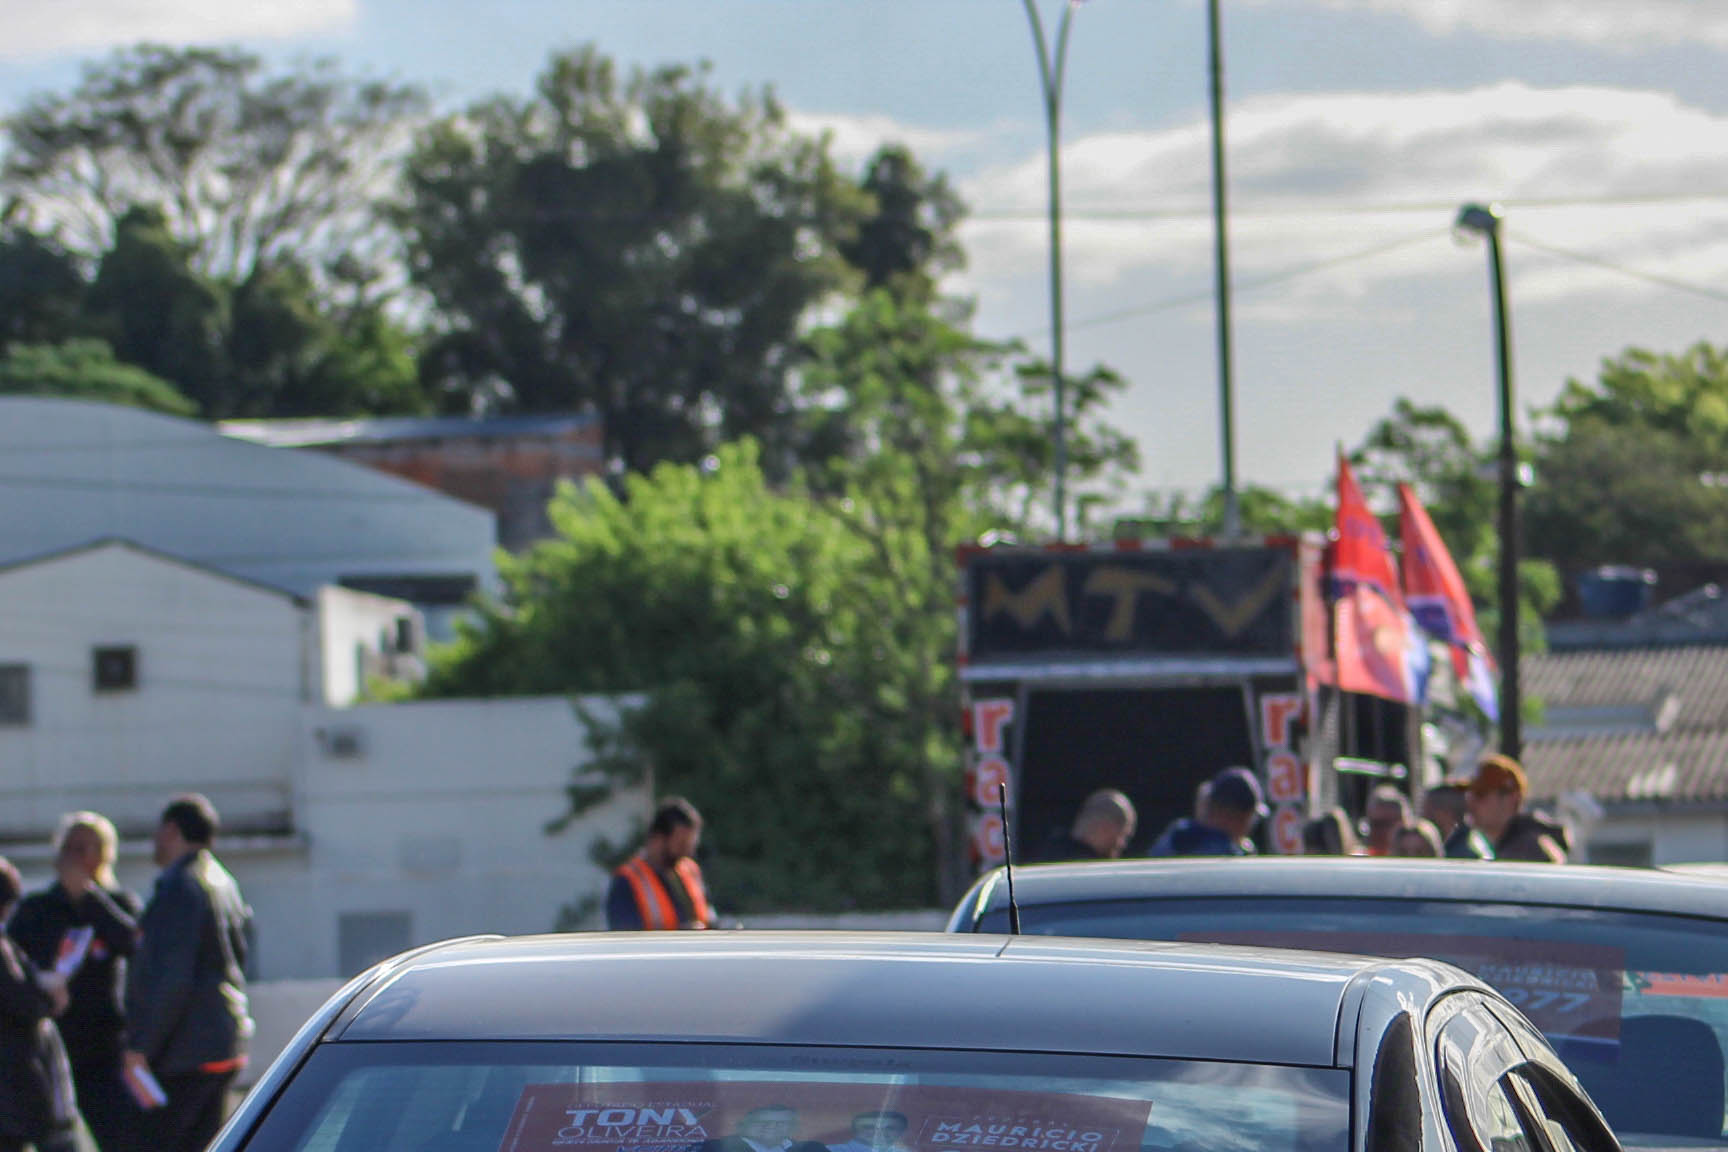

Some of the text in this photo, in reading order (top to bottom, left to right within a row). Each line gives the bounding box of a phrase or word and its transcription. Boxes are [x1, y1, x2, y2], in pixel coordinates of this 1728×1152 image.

[981, 562, 1286, 643] MTV
[1502, 987, 1592, 1013] 977
[565, 1108, 711, 1126] TONY
[557, 1124, 708, 1138] OLIVEIRA
[931, 1131, 1098, 1152] DZIEDRICKI
[936, 1121, 1103, 1143] MAURICIO
